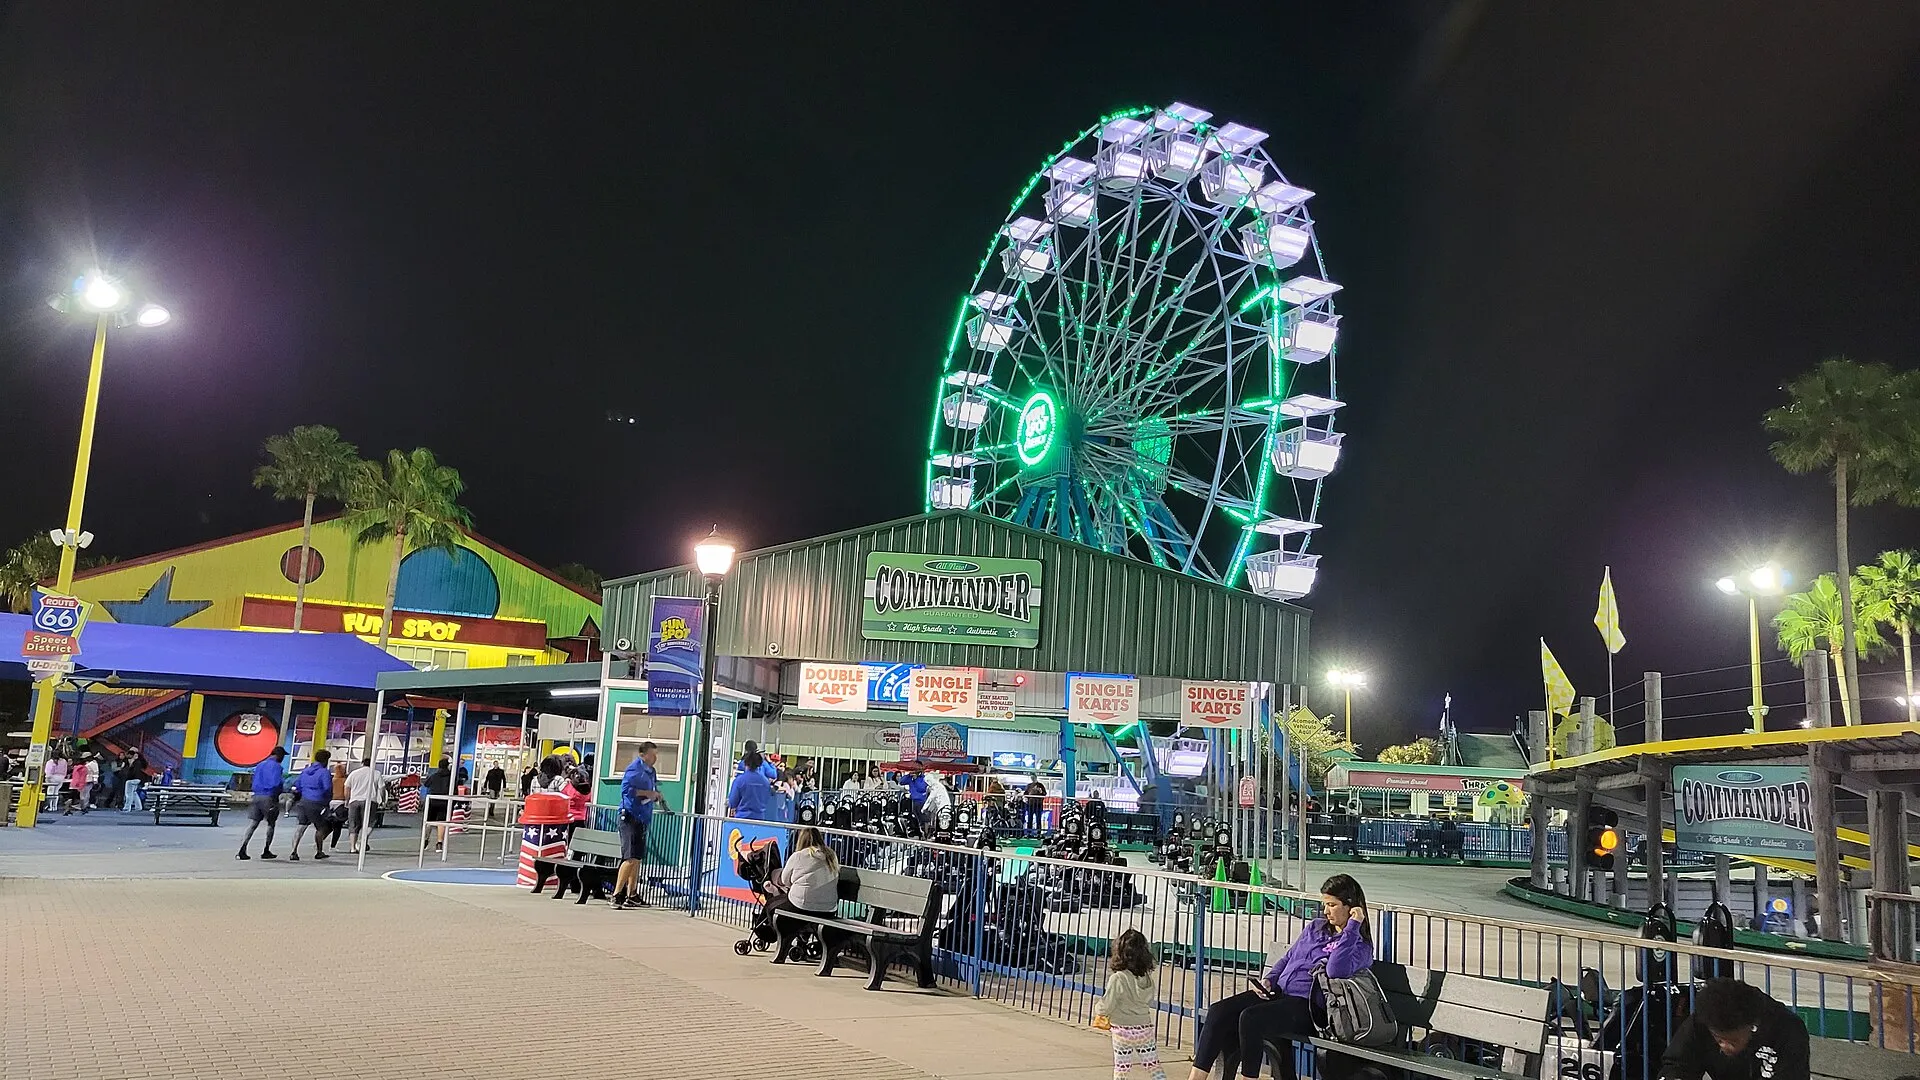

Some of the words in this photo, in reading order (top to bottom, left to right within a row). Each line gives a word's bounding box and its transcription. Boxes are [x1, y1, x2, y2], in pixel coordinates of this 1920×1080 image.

[874, 564, 1031, 623] COMMANDER
[45, 598, 75, 607] ROUTE
[42, 608, 73, 628] 66
[923, 610, 979, 619] GUARANTEED
[401, 618, 461, 641] SPOT
[660, 618, 686, 630] FUN
[902, 623, 920, 633] High
[921, 624, 943, 633] Grade
[966, 626, 998, 636] Authentic
[33, 635, 68, 645] Speed
[660, 627, 691, 642] SPOT
[26, 642, 72, 653] District
[31, 661, 69, 670] U-Drive
[805, 668, 864, 682] DOUBLE
[808, 682, 858, 696] KARTS
[915, 675, 972, 690] SINGLE
[918, 690, 968, 704] KARTS
[1075, 683, 1134, 698] SINGLE
[1187, 687, 1246, 702] SINGLE
[1078, 697, 1129, 712] KARTS
[1191, 701, 1242, 715] KARTS
[241, 721, 257, 731] 66
[1385, 777, 1410, 785] Premium
[1681, 777, 1814, 834] COMMANDER
[1760, 838, 1787, 848] Authentic
[1560, 1057, 1603, 1080] 26
